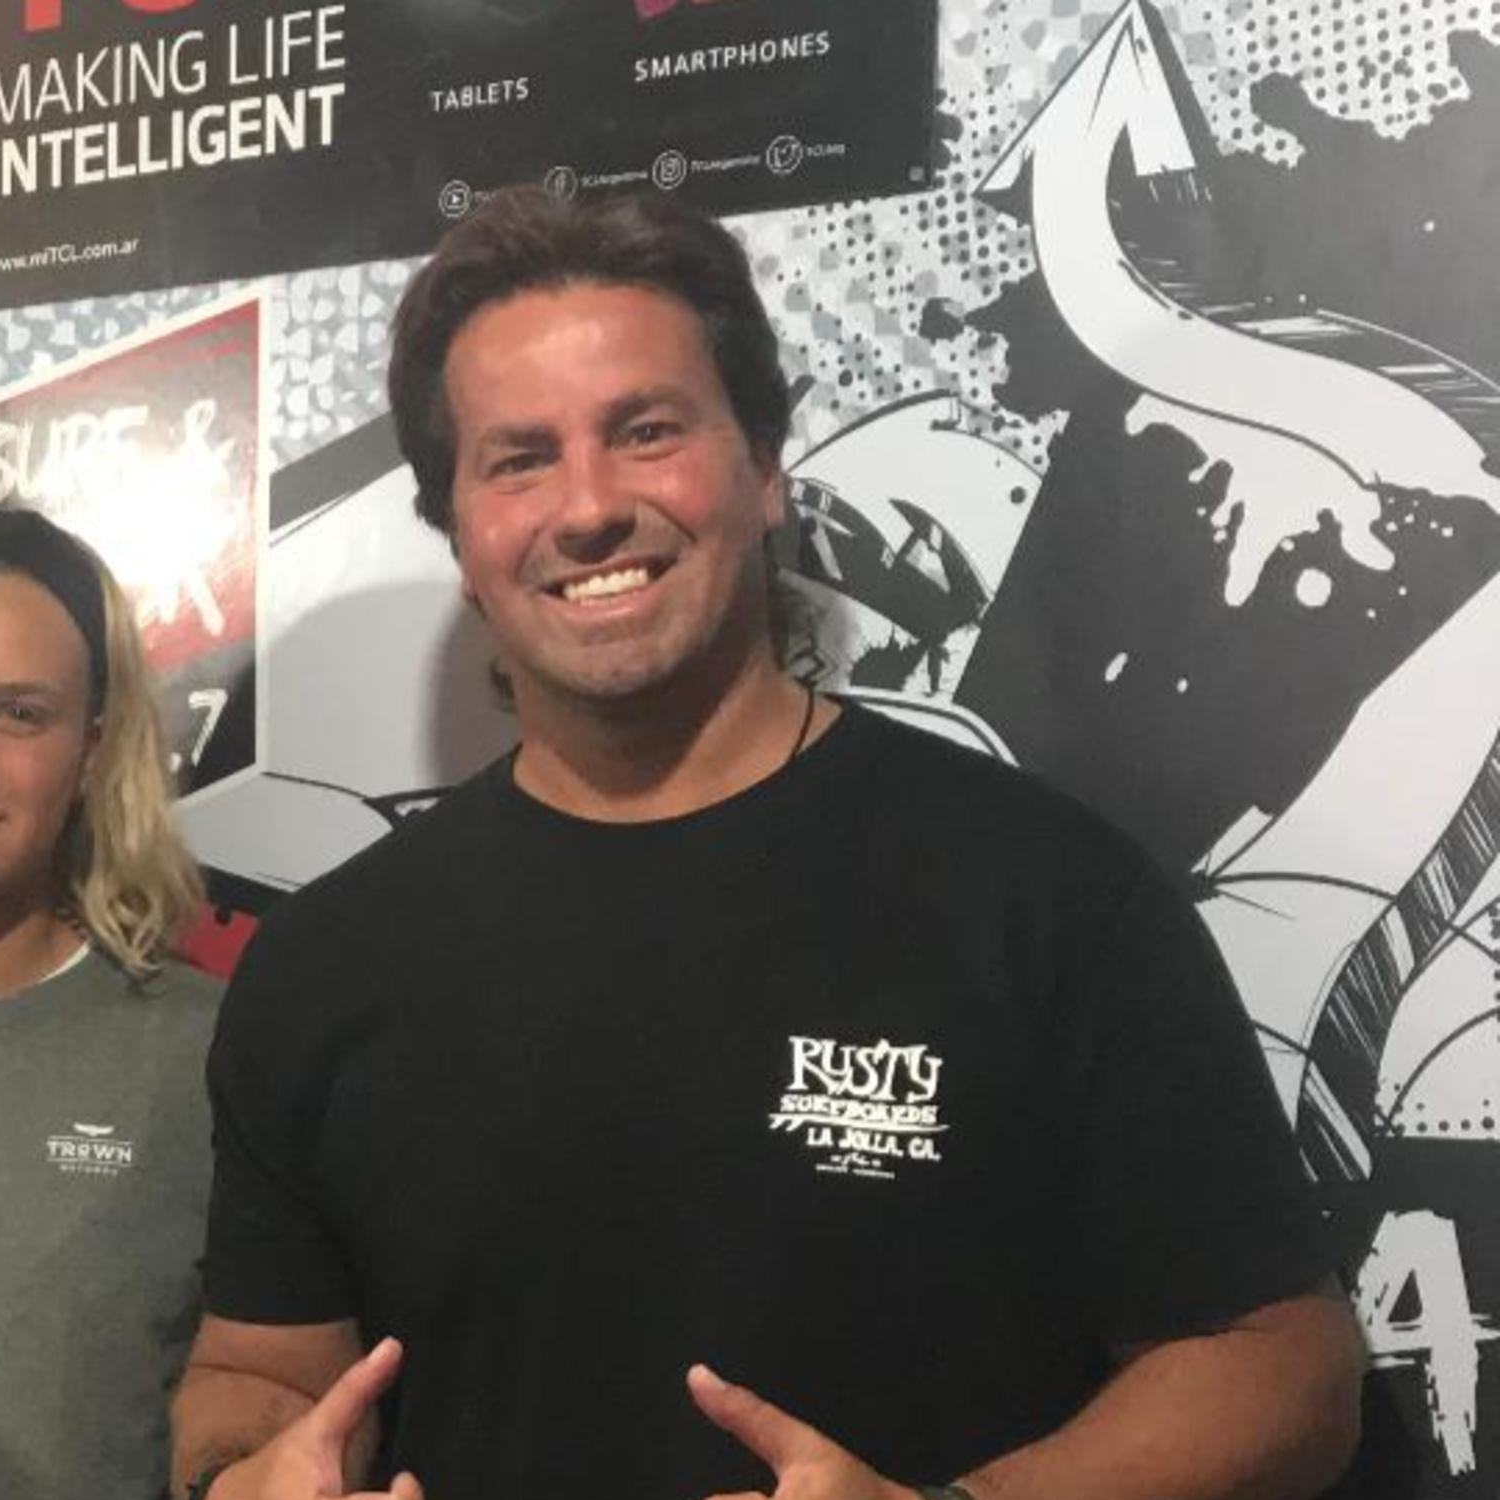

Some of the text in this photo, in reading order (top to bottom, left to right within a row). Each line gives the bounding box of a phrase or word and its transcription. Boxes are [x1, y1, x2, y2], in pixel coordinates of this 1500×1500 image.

[229, 4, 346, 86] LIFE
[634, 31, 832, 82] SMARTPHONES
[430, 77, 530, 112] TABLETS
[787, 1034, 944, 1105] RUSTY
[806, 1127, 834, 1147] LA
